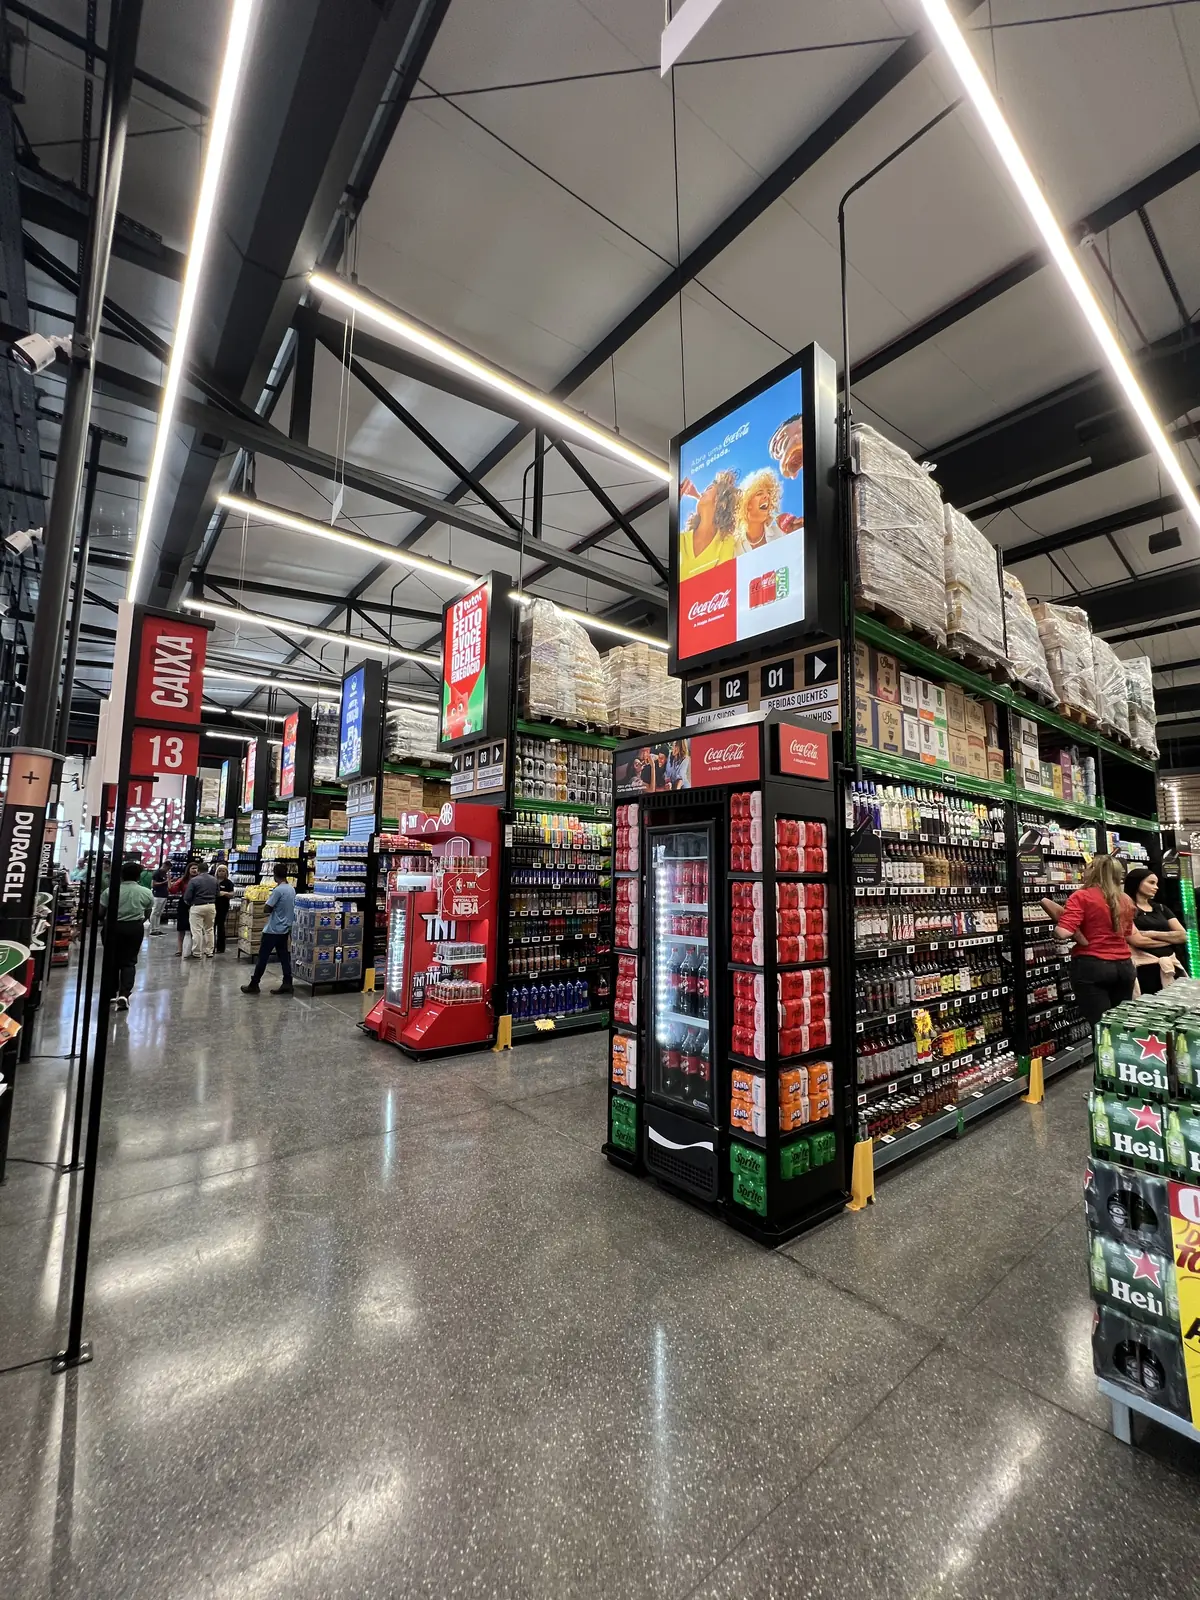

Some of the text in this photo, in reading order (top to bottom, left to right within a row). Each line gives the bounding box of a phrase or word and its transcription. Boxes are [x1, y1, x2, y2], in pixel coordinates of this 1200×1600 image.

[688, 588, 732, 620] Coca-Cola
[452, 607, 482, 640] FEITO
[452, 642, 480, 672] IDEAL
[150, 635, 193, 708] CAIXA
[768, 668, 784, 689] 01
[725, 679, 741, 699] 02
[767, 688, 828, 709] BEBIDAS QUENTES
[149, 735, 183, 768] 13
[480, 751, 487, 763] 03
[704, 742, 746, 765] Coca-Cola
[789, 739, 819, 760] Coca-Cola
[3, 811, 34, 903] DURACELL
[40, 843, 51, 878] DURACELL
[452, 902, 479, 914] NBA
[421, 914, 456, 941] TNT
[413, 976, 425, 987] TNT
[426, 971, 441, 985] TNT
[734, 1152, 761, 1172] Sprite
[737, 1183, 763, 1205] Sprite
